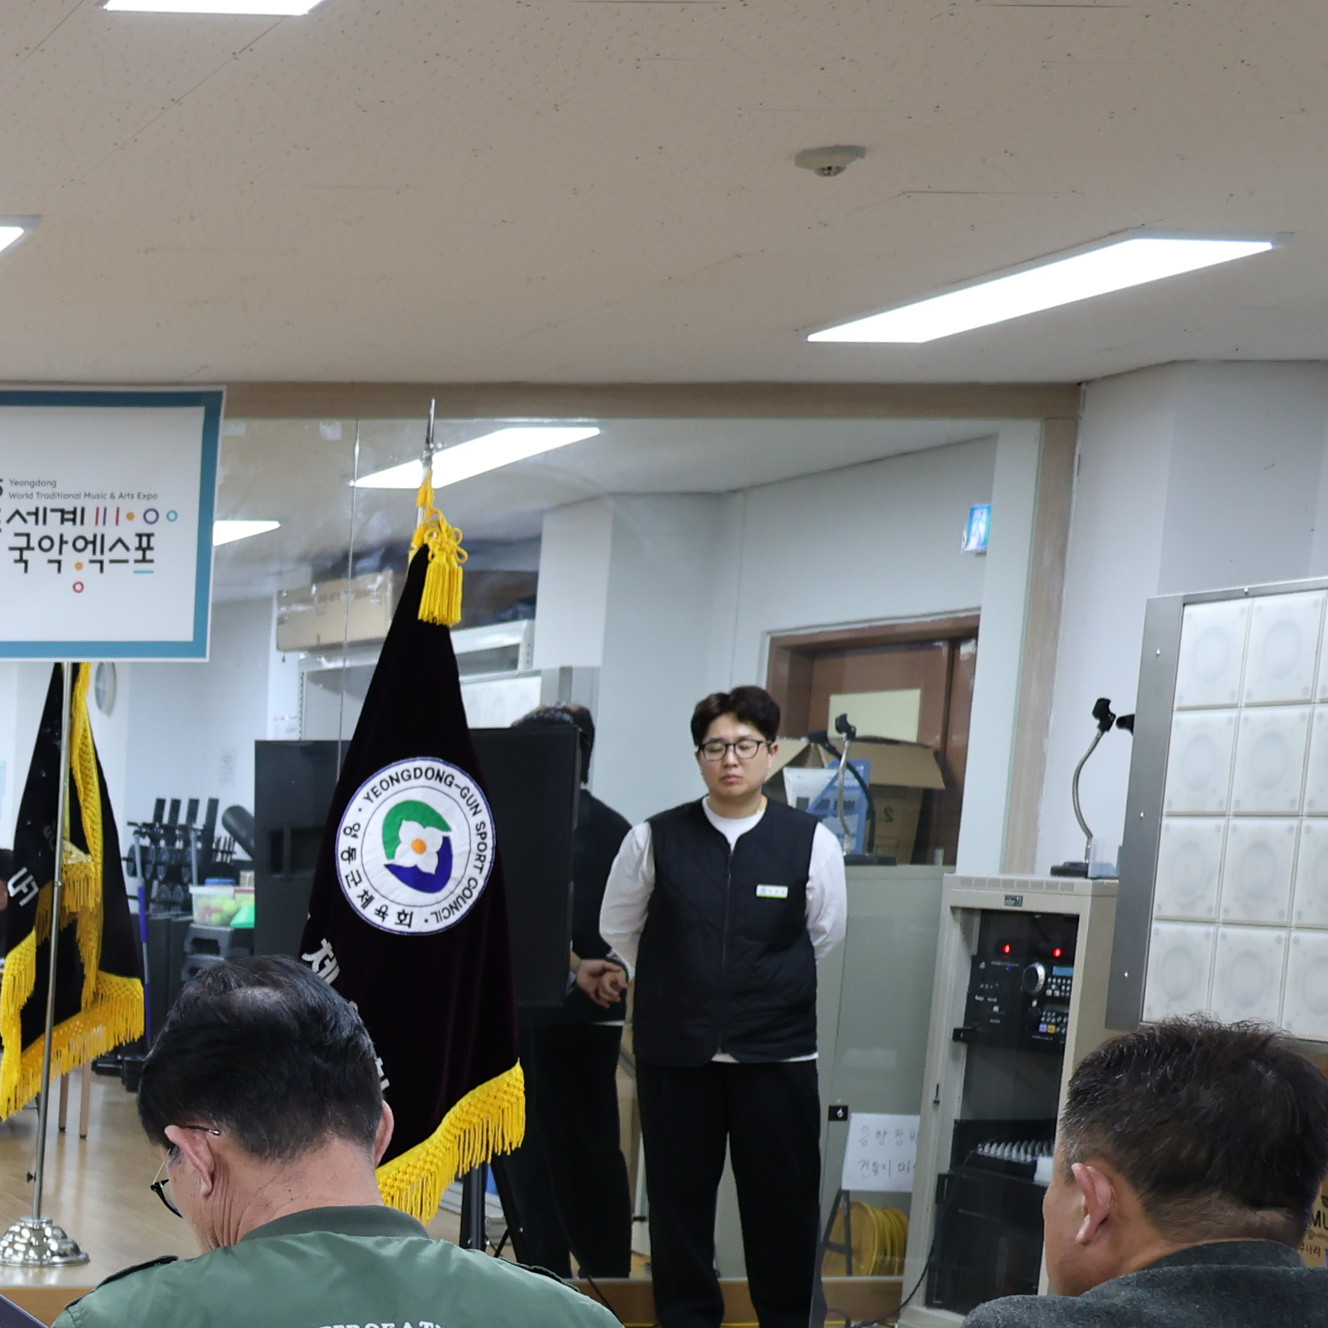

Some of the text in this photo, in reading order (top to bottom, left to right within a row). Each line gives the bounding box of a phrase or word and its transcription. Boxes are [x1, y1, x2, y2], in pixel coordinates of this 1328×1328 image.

[8, 491, 158, 501] World Traditional Music & Arts Expo
[9, 479, 57, 488] Yeongdong
[8, 532, 155, 574] 국악엑스포
[362, 767, 488, 924] YEONGDONG-GUN SPORT COUNCIL
[341, 822, 414, 928] 영동군체육회
